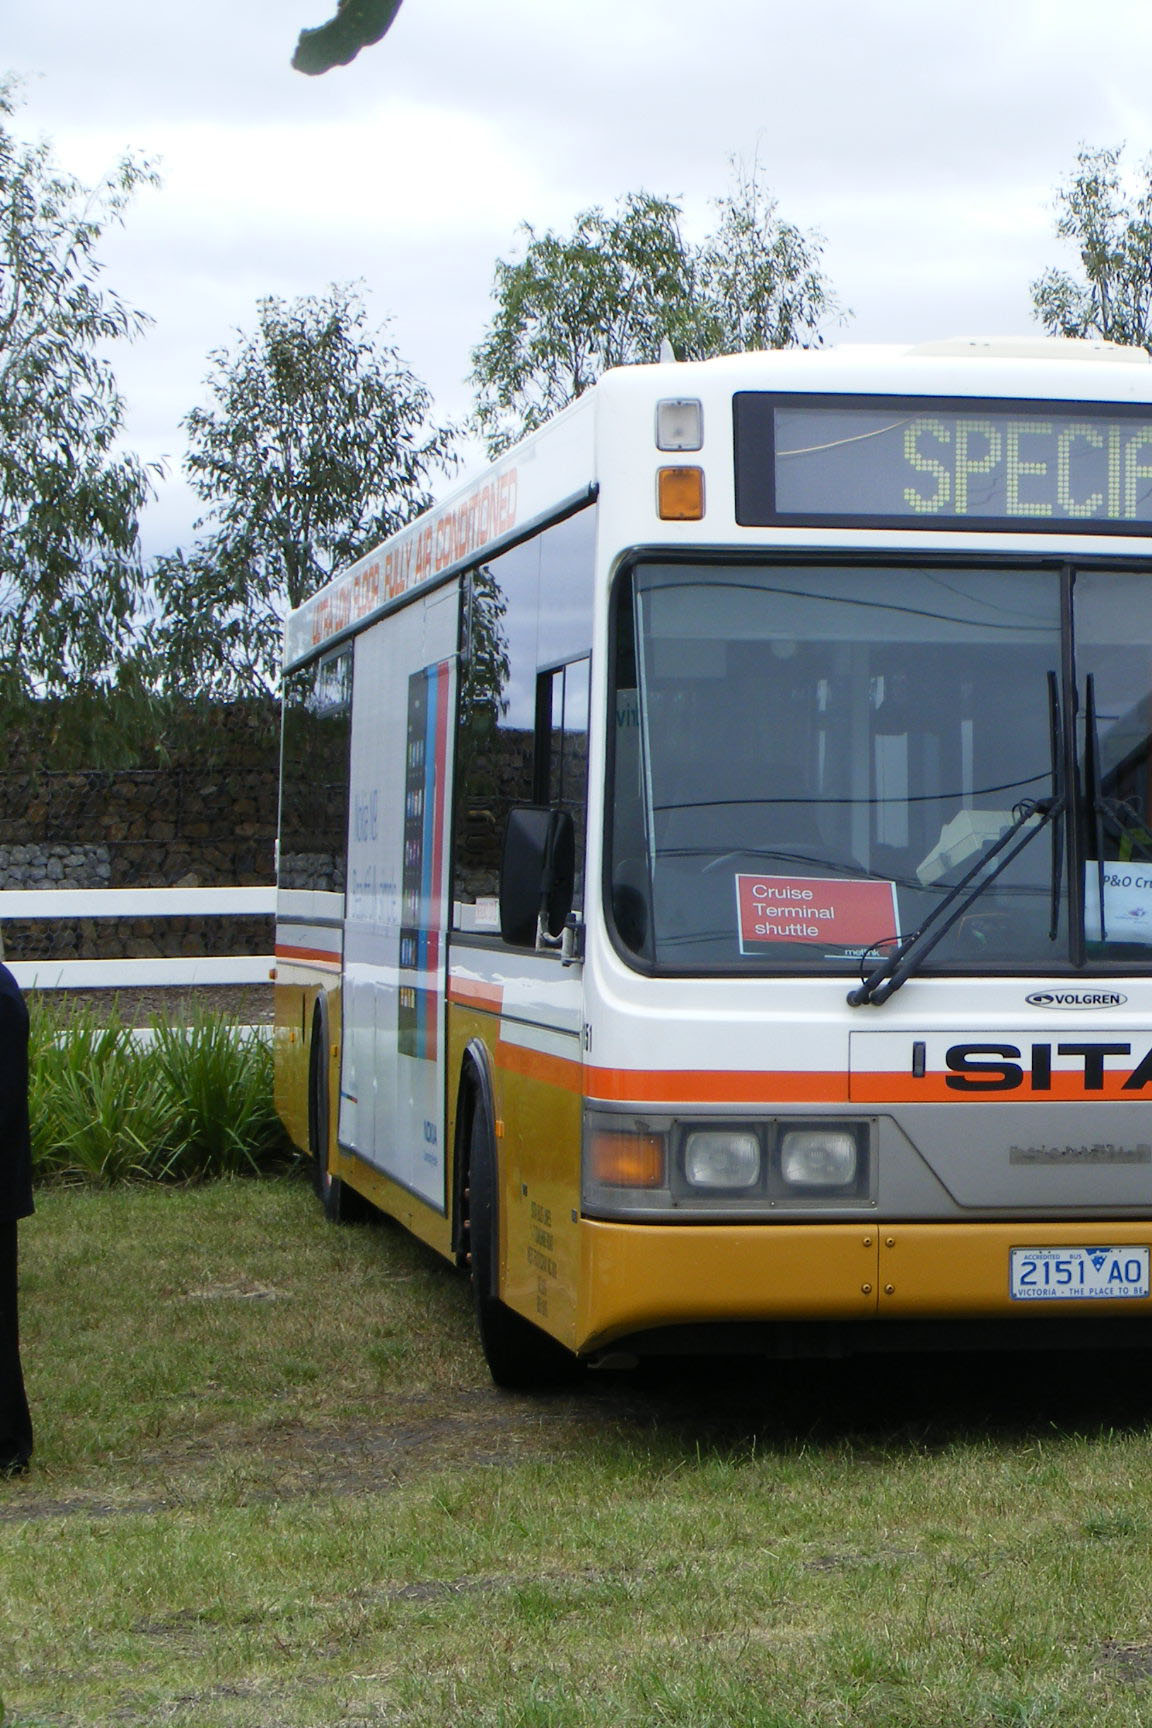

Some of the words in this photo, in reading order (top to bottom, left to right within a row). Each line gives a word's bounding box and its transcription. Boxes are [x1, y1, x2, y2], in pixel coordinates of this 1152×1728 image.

[384, 538, 413, 601] FULLY
[414, 525, 432, 586] AIR
[435, 467, 518, 572] CONDITIONED
[752, 884, 814, 900] Cruise
[753, 903, 835, 920] Terminal
[755, 922, 819, 937] shuttle
[1055, 994, 1120, 1004] VOLGREN
[1020, 1260, 1085, 1286] 2151
[1018, 1288, 1057, 1297] VICTORIA
[1069, 1288, 1084, 1296] THE
[1089, 1287, 1114, 1296] PLACE
[1118, 1287, 1129, 1295] TO
[1133, 1286, 1144, 1295] BE
